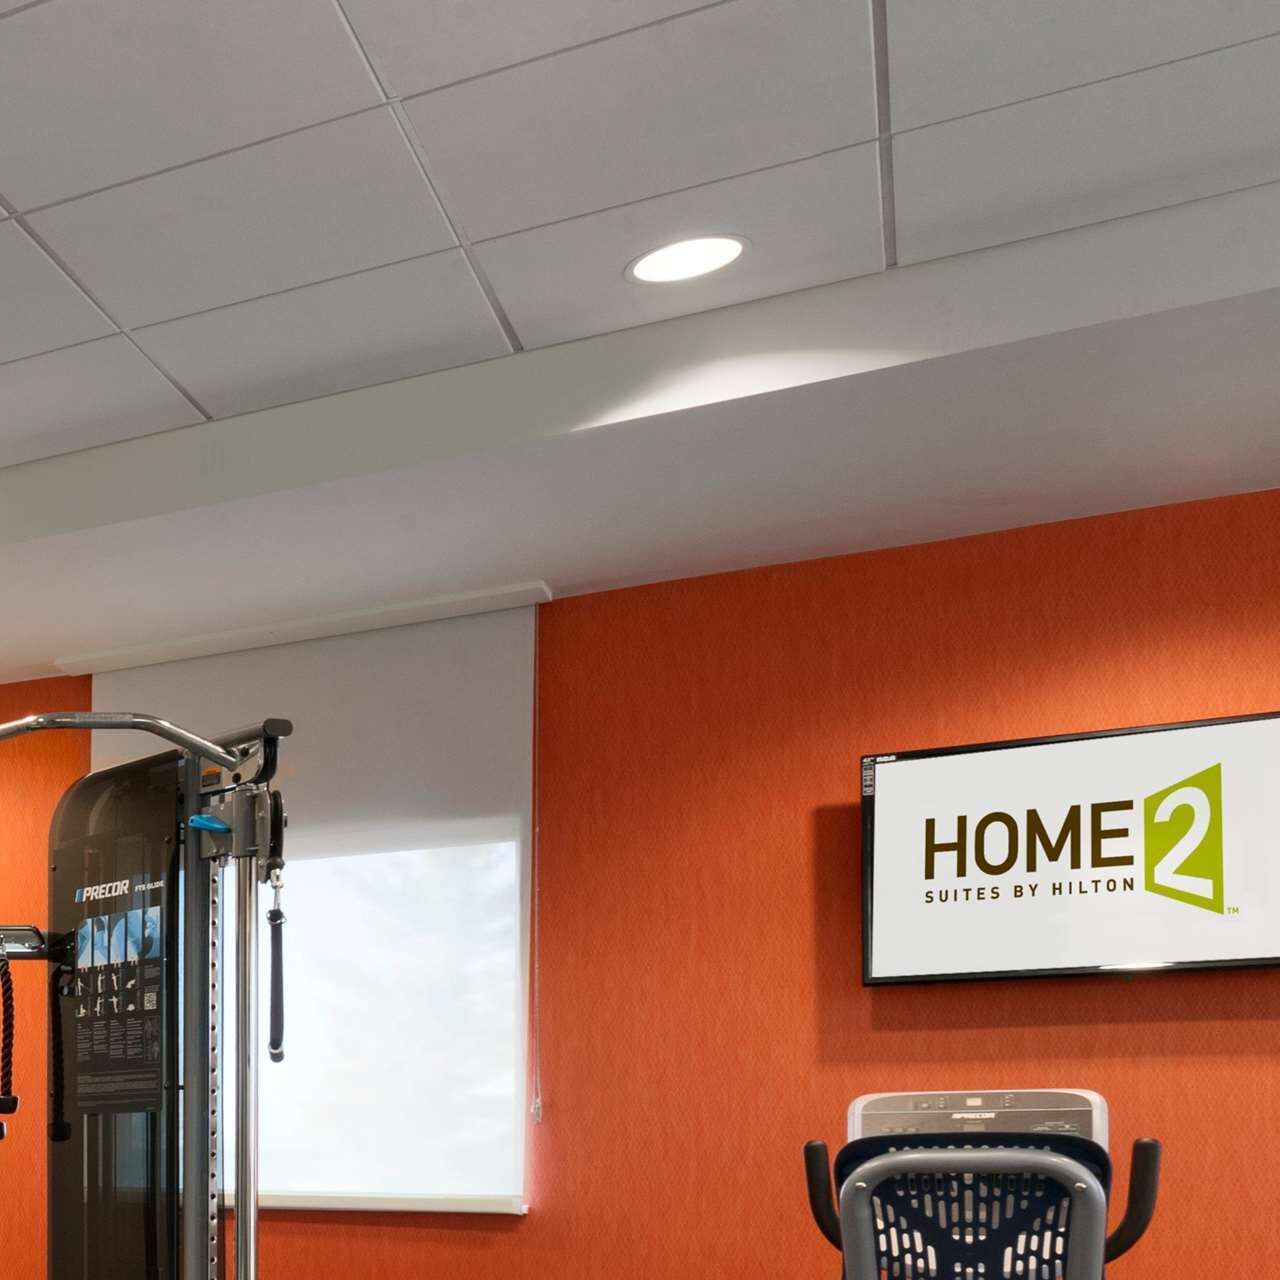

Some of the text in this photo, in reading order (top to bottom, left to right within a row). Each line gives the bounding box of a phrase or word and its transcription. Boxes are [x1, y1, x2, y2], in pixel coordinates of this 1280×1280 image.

[924, 786, 1214, 900] HOME 2
[82, 879, 130, 903] PRECOR
[925, 877, 1136, 904] SUITES BY HILTON
